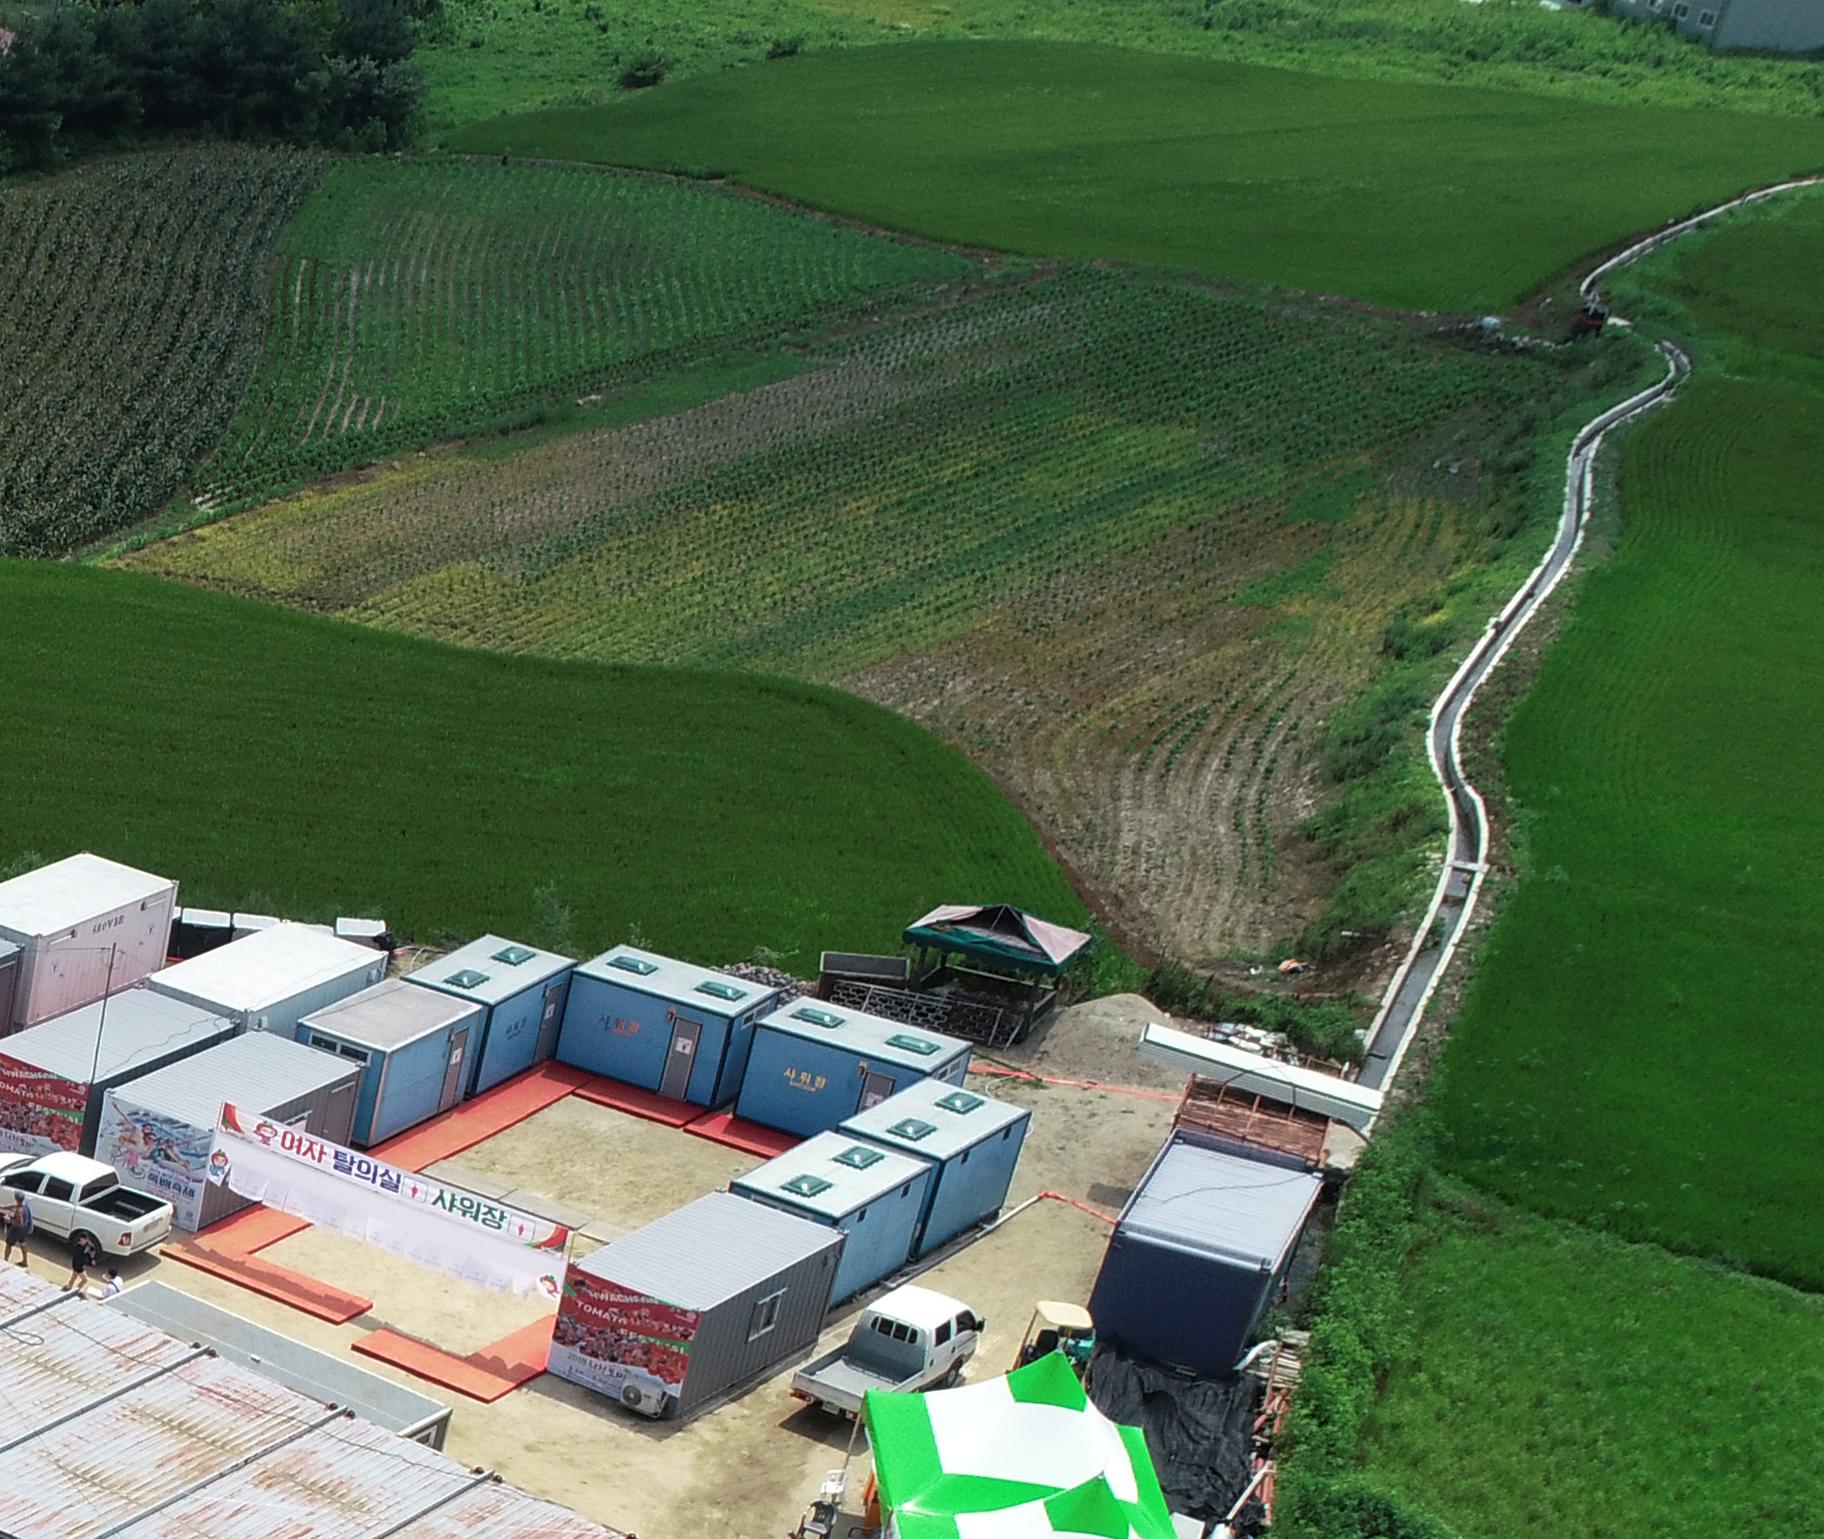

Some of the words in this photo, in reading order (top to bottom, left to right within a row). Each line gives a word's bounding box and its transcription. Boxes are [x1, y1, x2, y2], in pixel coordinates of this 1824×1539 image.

[783, 1067, 827, 1089] 샤워장
[280, 1129, 327, 1165] 여자
[331, 1149, 403, 1194] 탈의실
[431, 1188, 508, 1232] 샤워장
[575, 1300, 628, 1325] TOMATO
